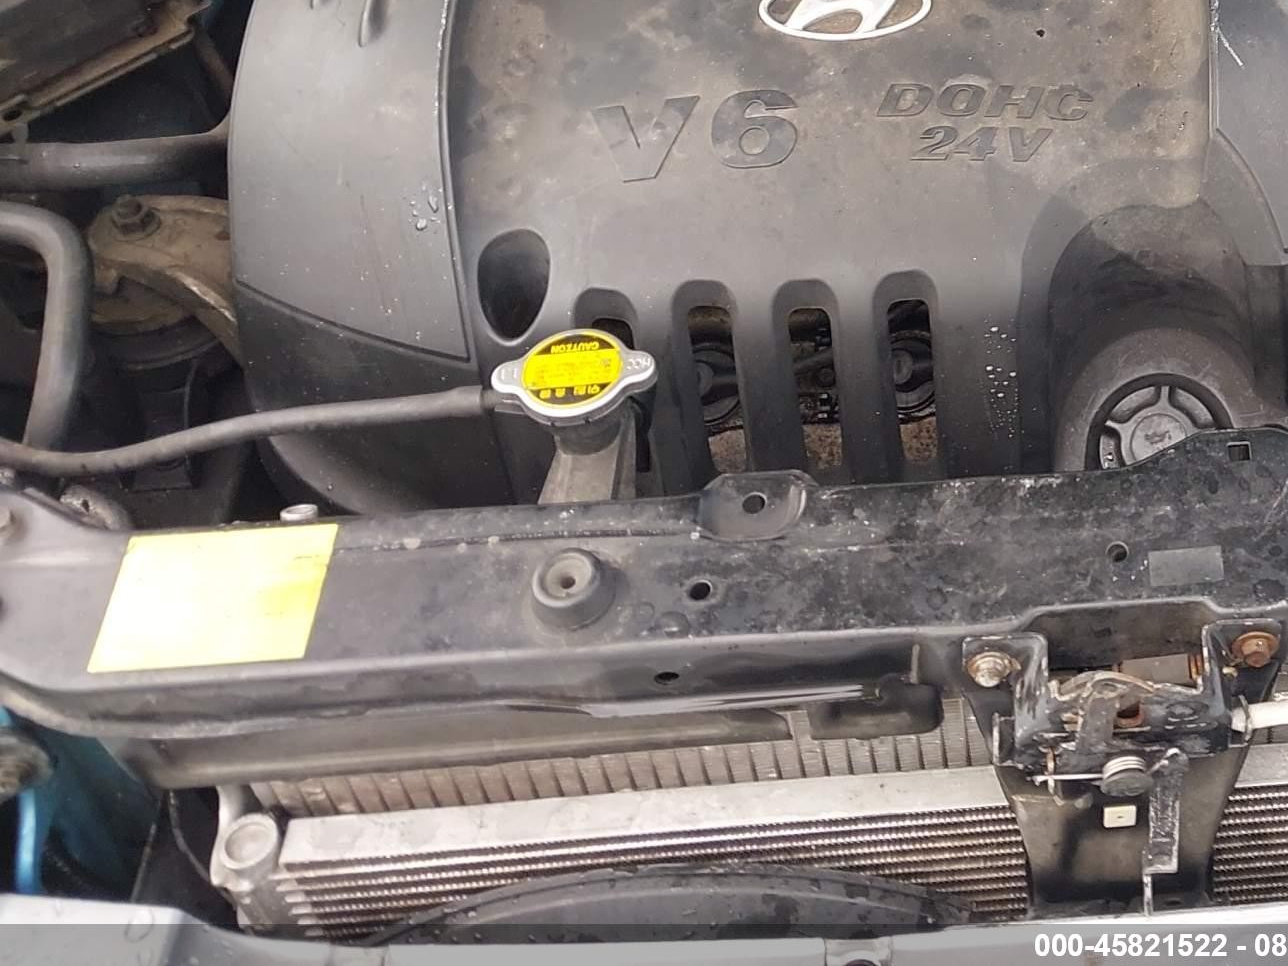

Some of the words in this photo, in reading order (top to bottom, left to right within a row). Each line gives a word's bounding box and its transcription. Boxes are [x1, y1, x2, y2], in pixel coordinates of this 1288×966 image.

[876, 82, 1095, 121] DOHC
[592, 89, 799, 183] V6
[910, 125, 1055, 163] 24V
[549, 341, 600, 355] CAUTION
